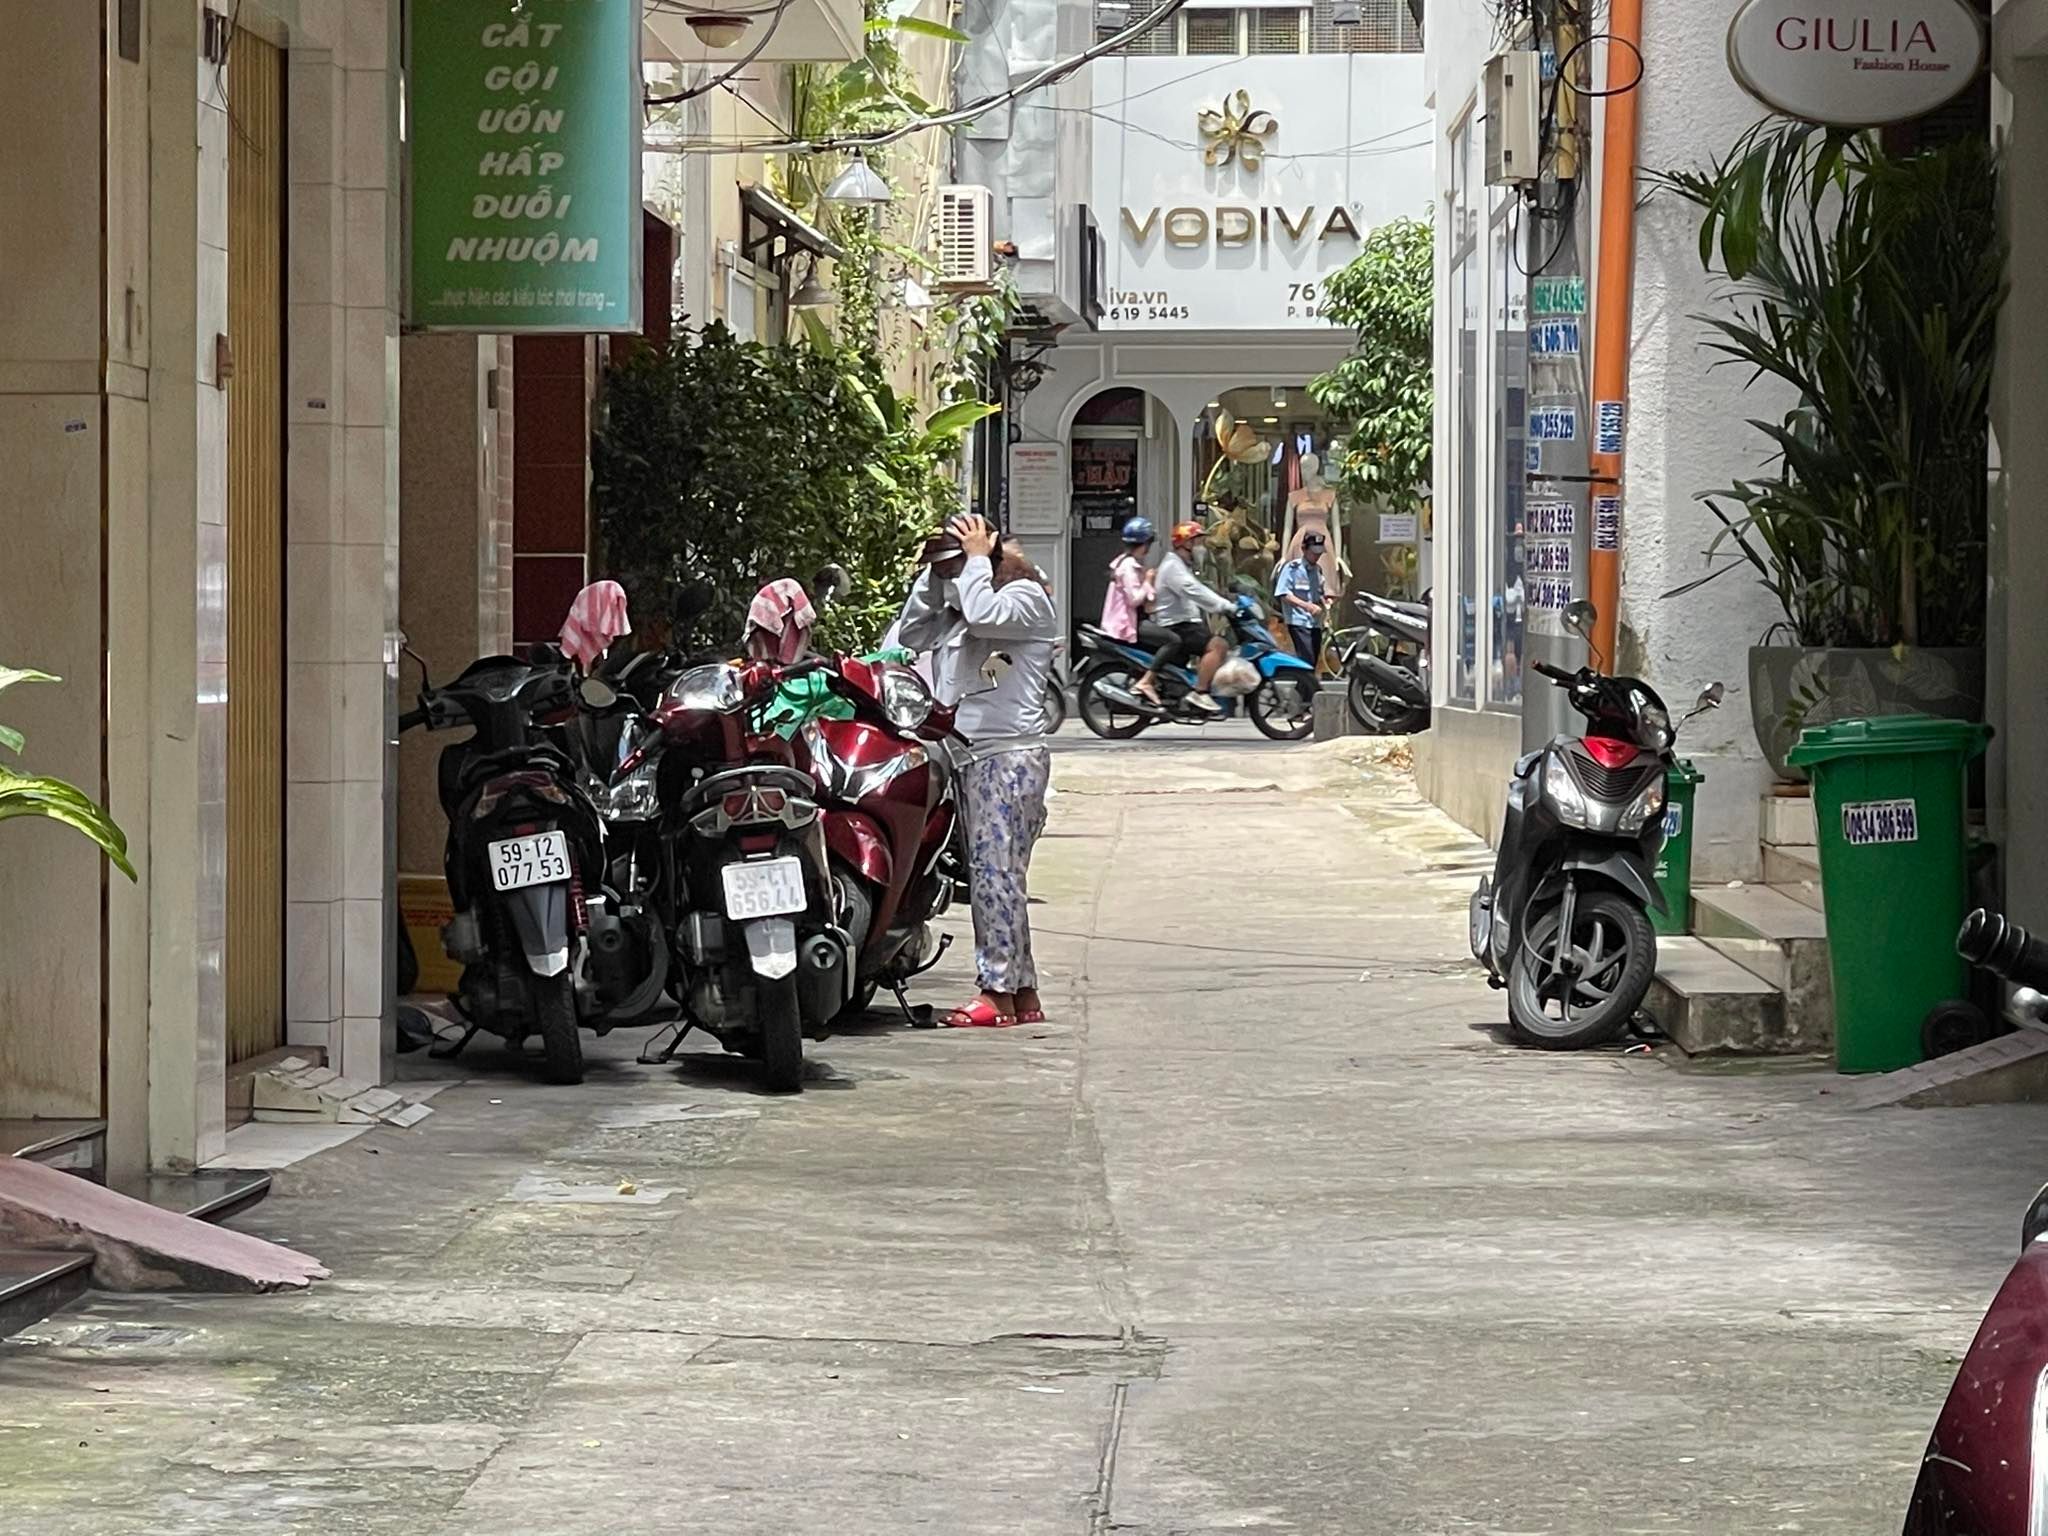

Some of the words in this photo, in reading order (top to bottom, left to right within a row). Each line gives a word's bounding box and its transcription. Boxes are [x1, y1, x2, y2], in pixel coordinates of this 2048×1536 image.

[481, 12, 562, 48] CẮT
[1776, 17, 1936, 53] GIULIA
[484, 60, 559, 95] GỘI
[1853, 58, 1904, 71] Fashion
[1908, 58, 1950, 72] House
[477, 99, 564, 133] UỐN
[479, 142, 564, 176] HẤP
[472, 185, 572, 219] DUỖI
[1120, 206, 1361, 242] VODIVA
[446, 232, 598, 266] NHUỘM
[1288, 283, 1316, 301] 76
[1149, 306, 1189, 320] 5445
[500, 838, 555, 863] 59-T2
[498, 857, 565, 887] 077.53
